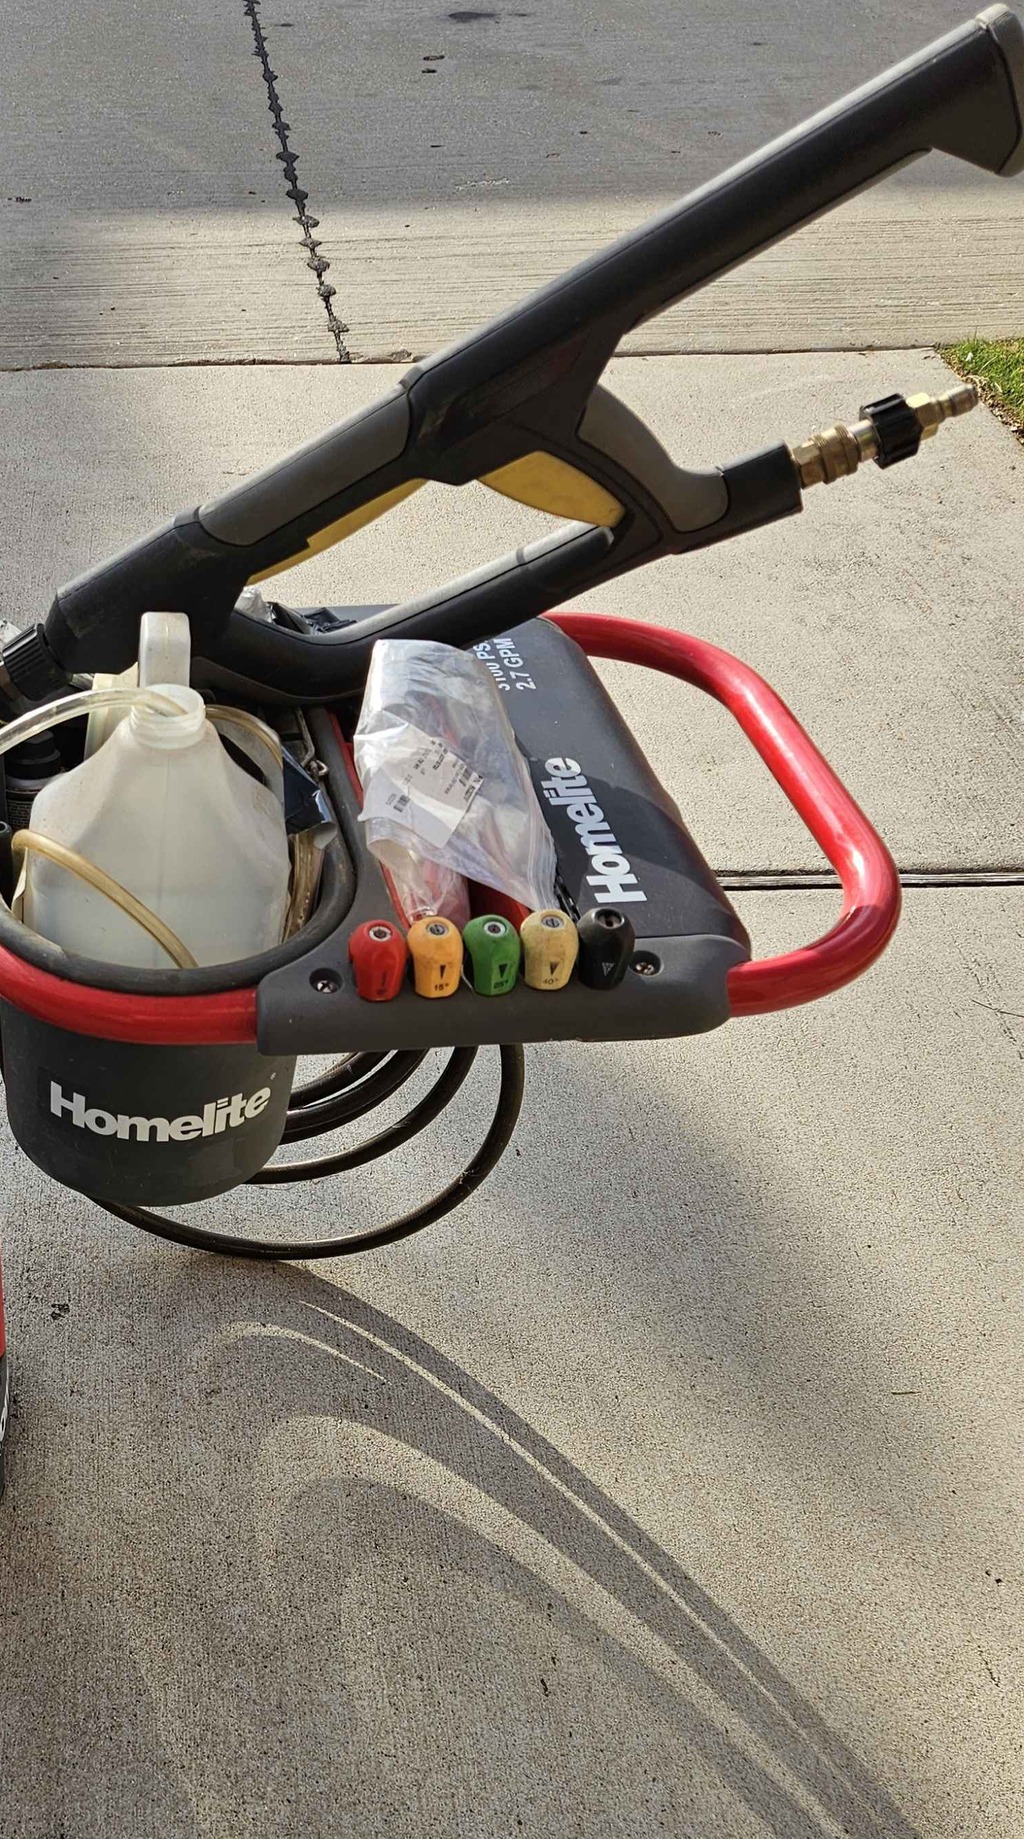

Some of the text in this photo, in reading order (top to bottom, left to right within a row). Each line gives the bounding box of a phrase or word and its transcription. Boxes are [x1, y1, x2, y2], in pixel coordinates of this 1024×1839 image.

[473, 640, 496, 660] PS
[493, 637, 536, 690] 2.7 GPM
[541, 757, 647, 903] Homelite
[50, 1080, 272, 1142] Homelite
